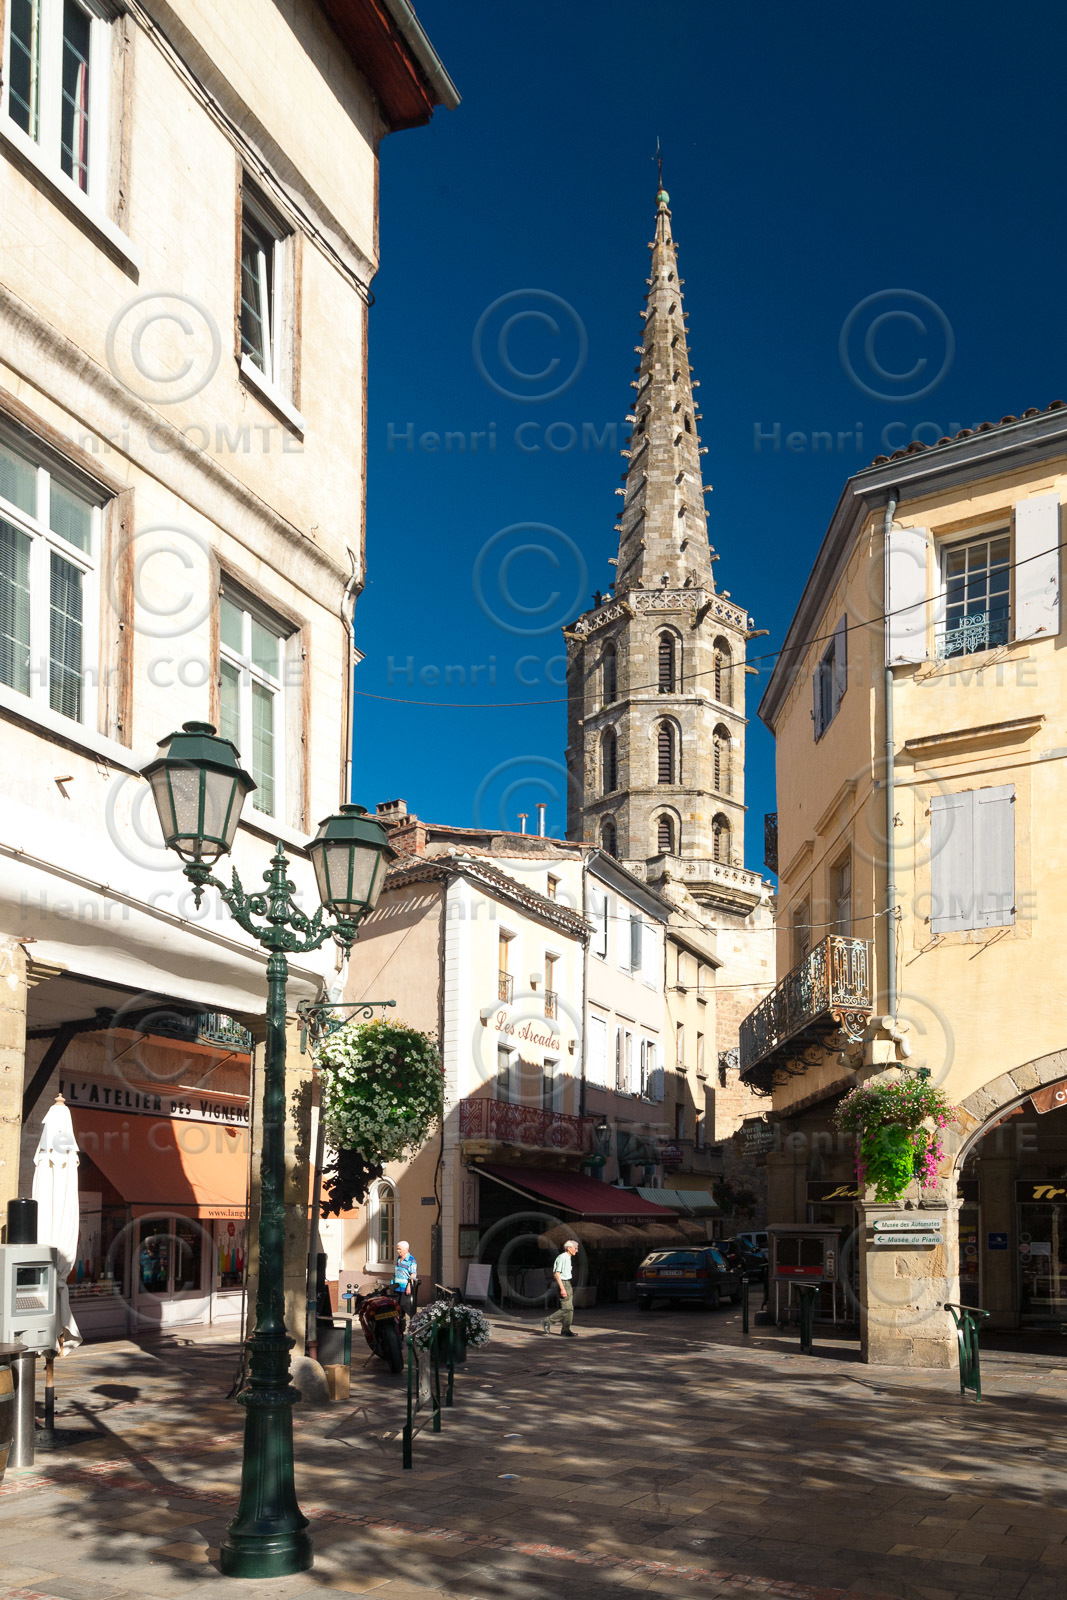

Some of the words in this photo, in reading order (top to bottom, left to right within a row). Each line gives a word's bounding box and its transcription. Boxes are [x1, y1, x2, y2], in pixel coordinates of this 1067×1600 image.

[495, 1011, 515, 1035] Les
[518, 1022, 560, 1050] Arcades
[1033, 1185, 1067, 1199] Tr
